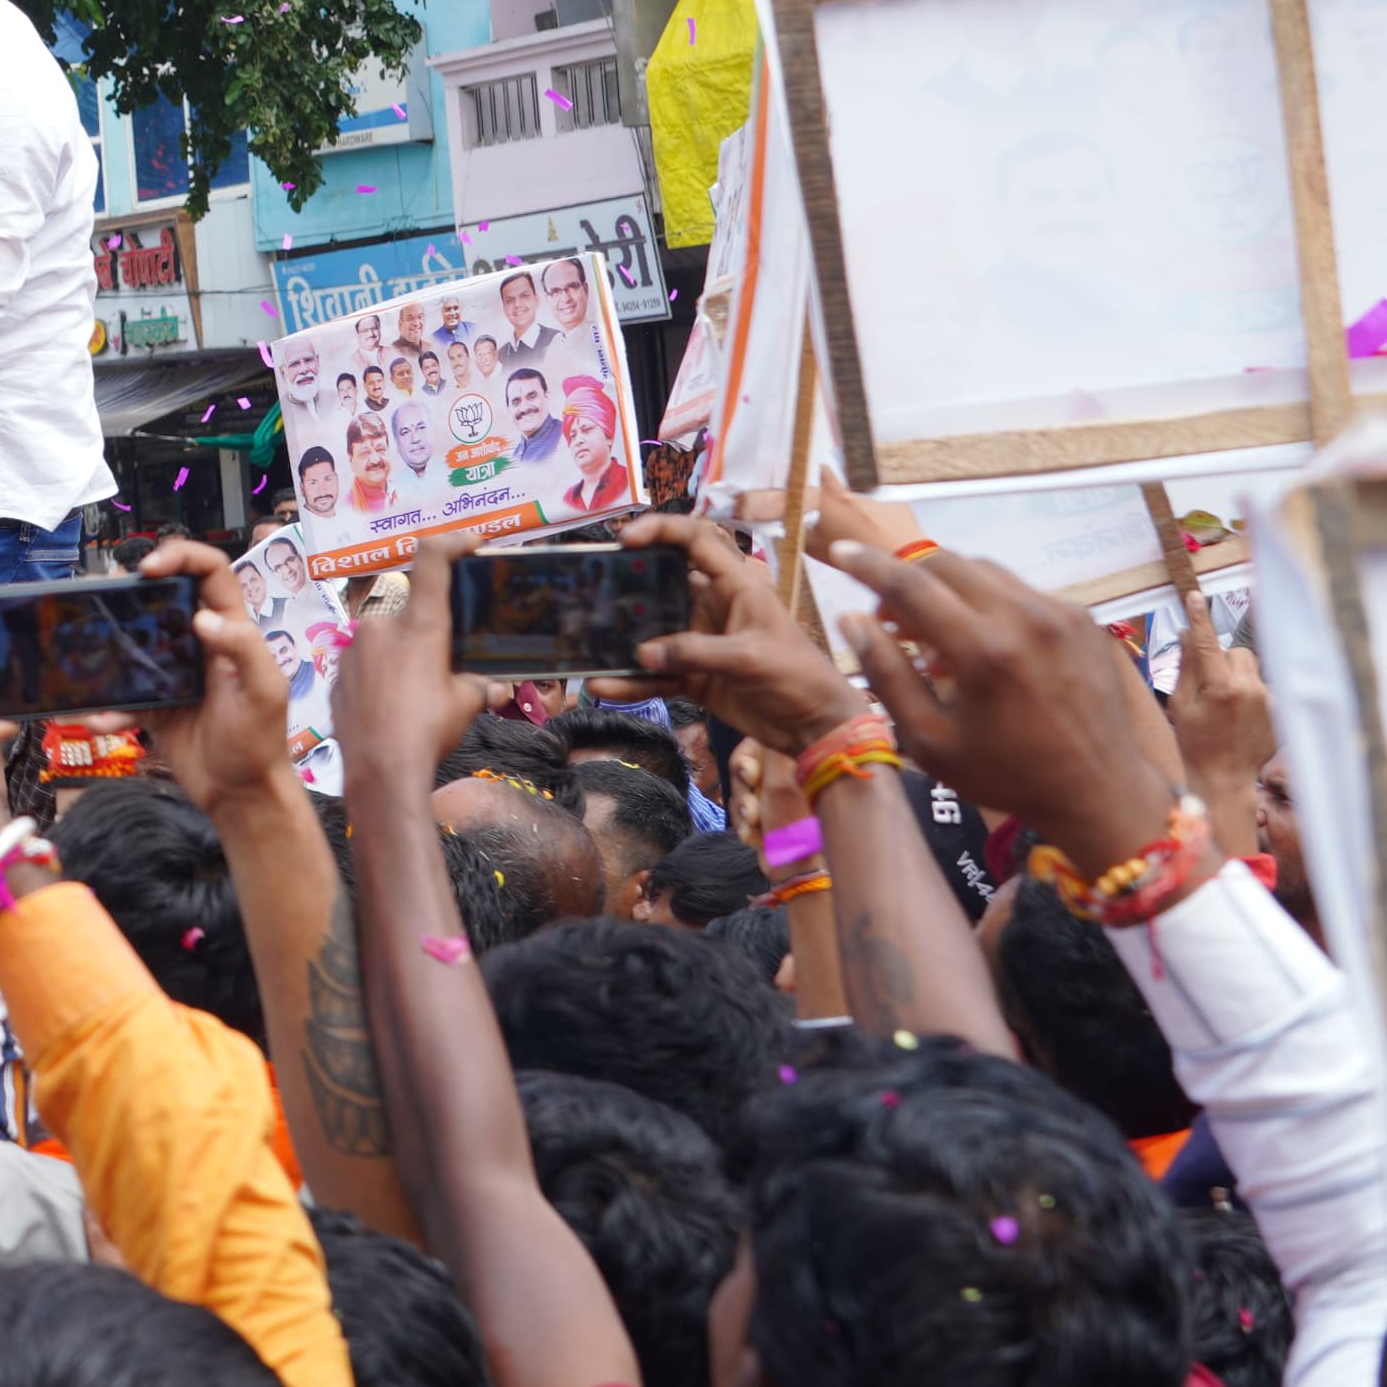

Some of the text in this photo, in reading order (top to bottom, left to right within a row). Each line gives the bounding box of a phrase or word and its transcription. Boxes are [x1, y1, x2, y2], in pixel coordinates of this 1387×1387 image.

[287, 264, 383, 333] शिवानी
[464, 461, 495, 481] यात्रा
[442, 486, 526, 517] अभिनंदन...
[311, 543, 391, 577] विशाल
